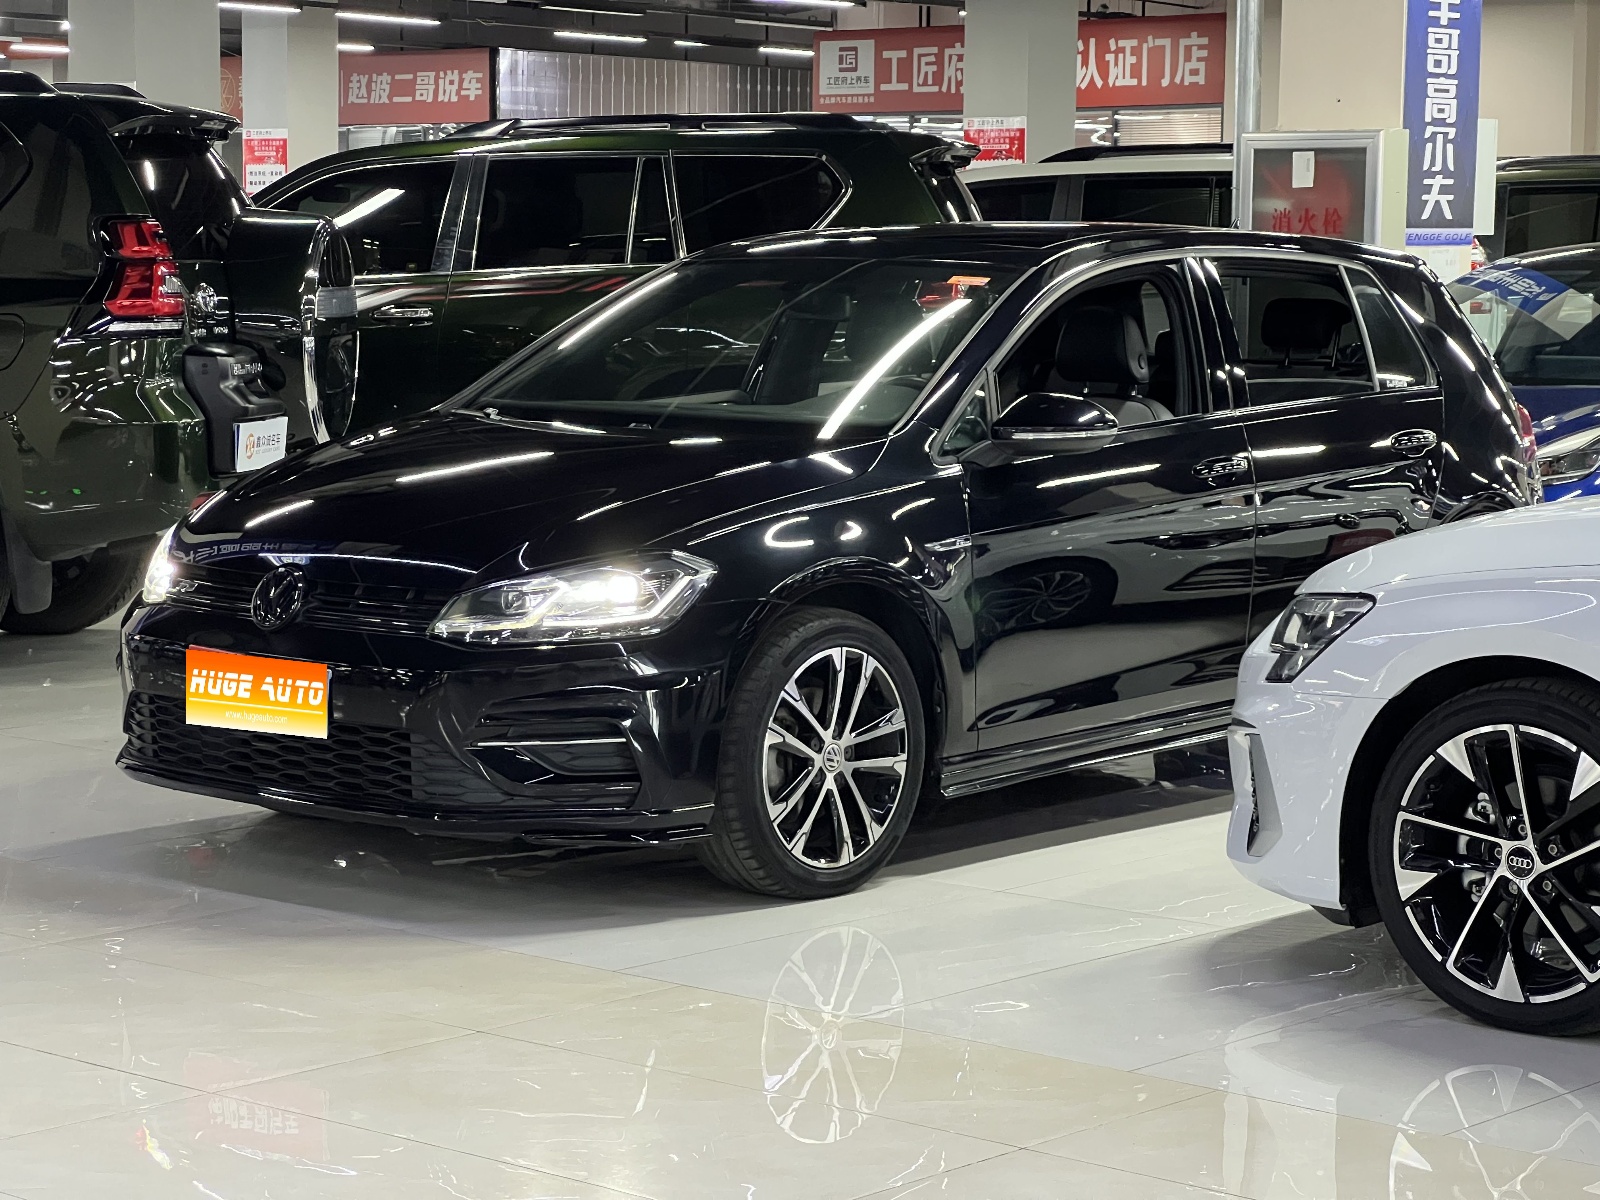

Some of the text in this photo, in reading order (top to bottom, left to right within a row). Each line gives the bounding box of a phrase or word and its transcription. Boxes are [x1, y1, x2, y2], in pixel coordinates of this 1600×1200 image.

[1076, 32, 1209, 90] 认证门店
[348, 70, 483, 104] 赵波二哥说车
[1273, 208, 1343, 235] 消火栓
[1406, 233, 1472, 241] ENGGE GOLF
